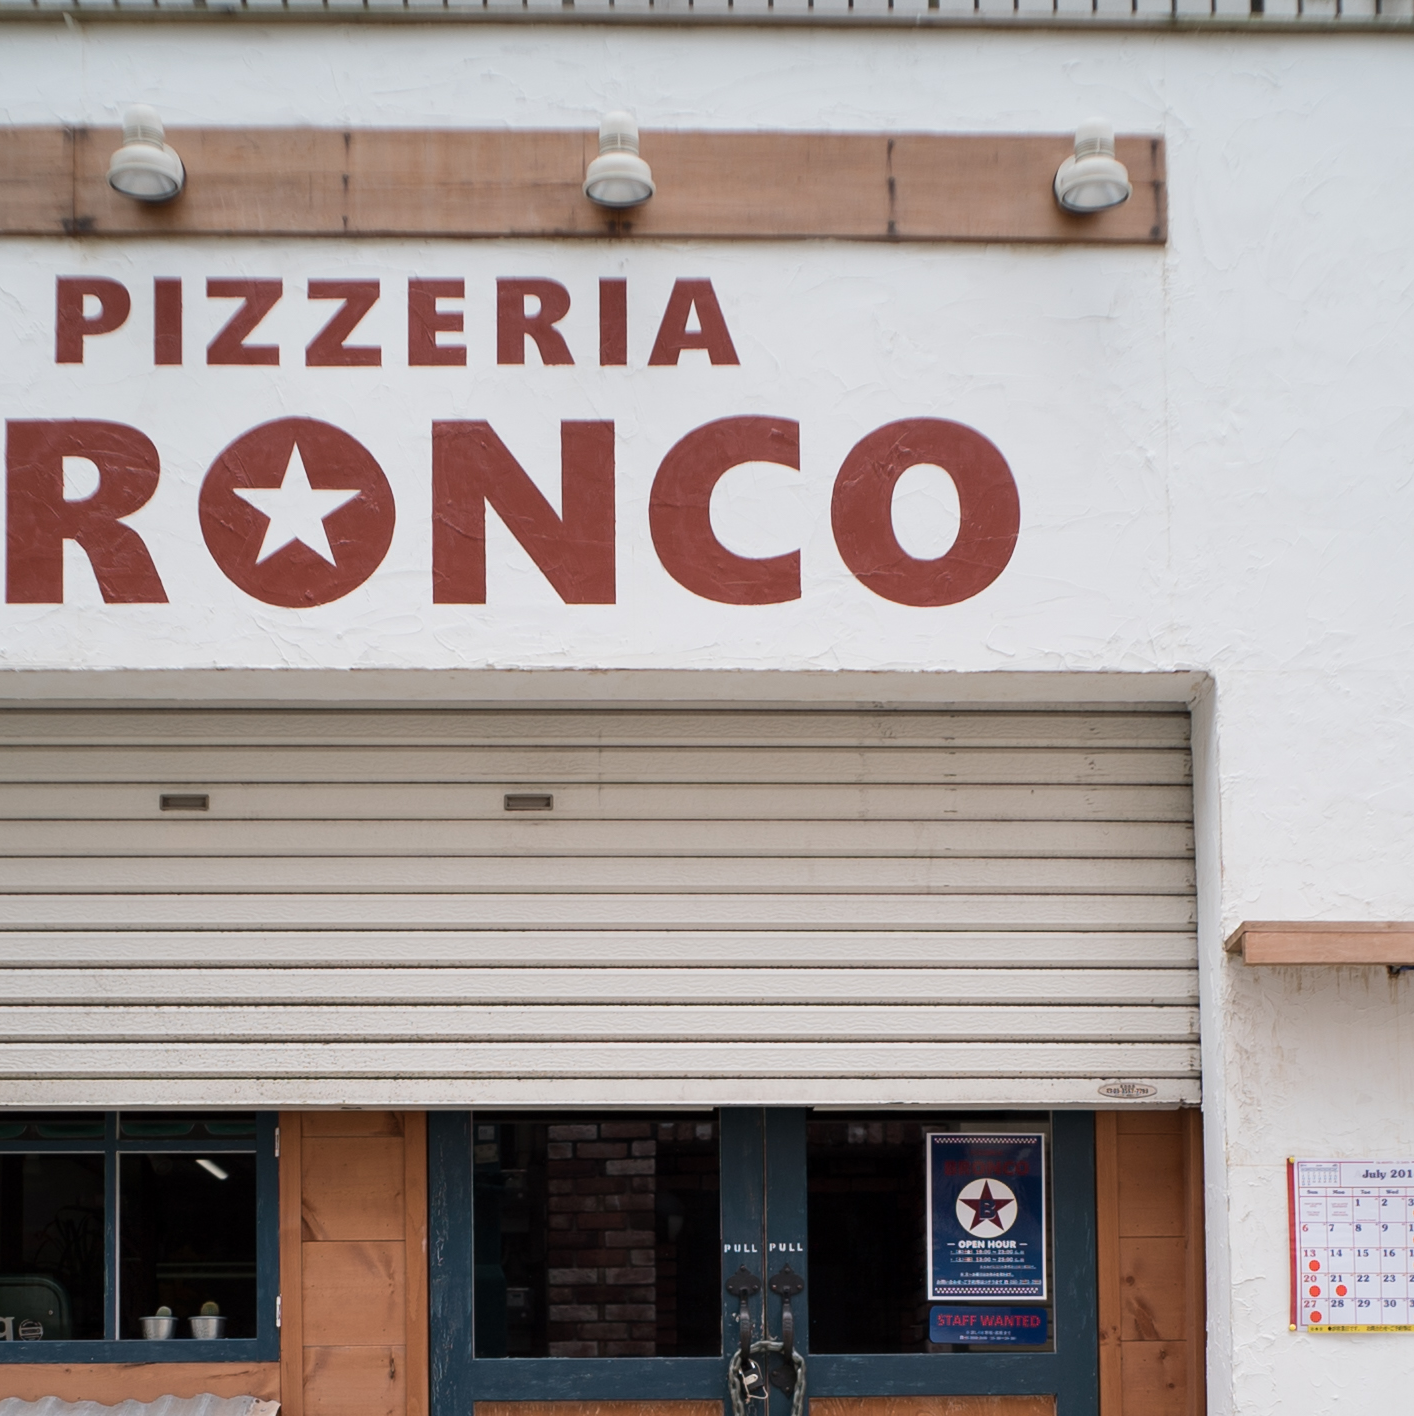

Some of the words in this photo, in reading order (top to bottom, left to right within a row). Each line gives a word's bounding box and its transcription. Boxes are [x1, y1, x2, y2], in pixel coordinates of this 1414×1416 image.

[55, 275, 740, 367] PIZZERIA
[943, 1160, 1030, 1176] BRONCO
[1362, 1169, 1387, 1181] July
[979, 1198, 996, 1220] B
[1302, 1224, 1308, 1232] 6
[1355, 1224, 1362, 1232] 8
[724, 1243, 758, 1253] PULL
[769, 1242, 803, 1252] PULL
[958, 1239, 985, 1249] OPEN
[988, 1239, 1017, 1249] HOUR
[1331, 1249, 1342, 1257] 14
[1358, 1249, 1369, 1257] 15
[1384, 1249, 1395, 1257] 16
[1304, 1300, 1316, 1308] 27
[1331, 1299, 1344, 1307] 28
[937, 1314, 977, 1326] STAFF
[980, 1314, 1041, 1328] WANTED
